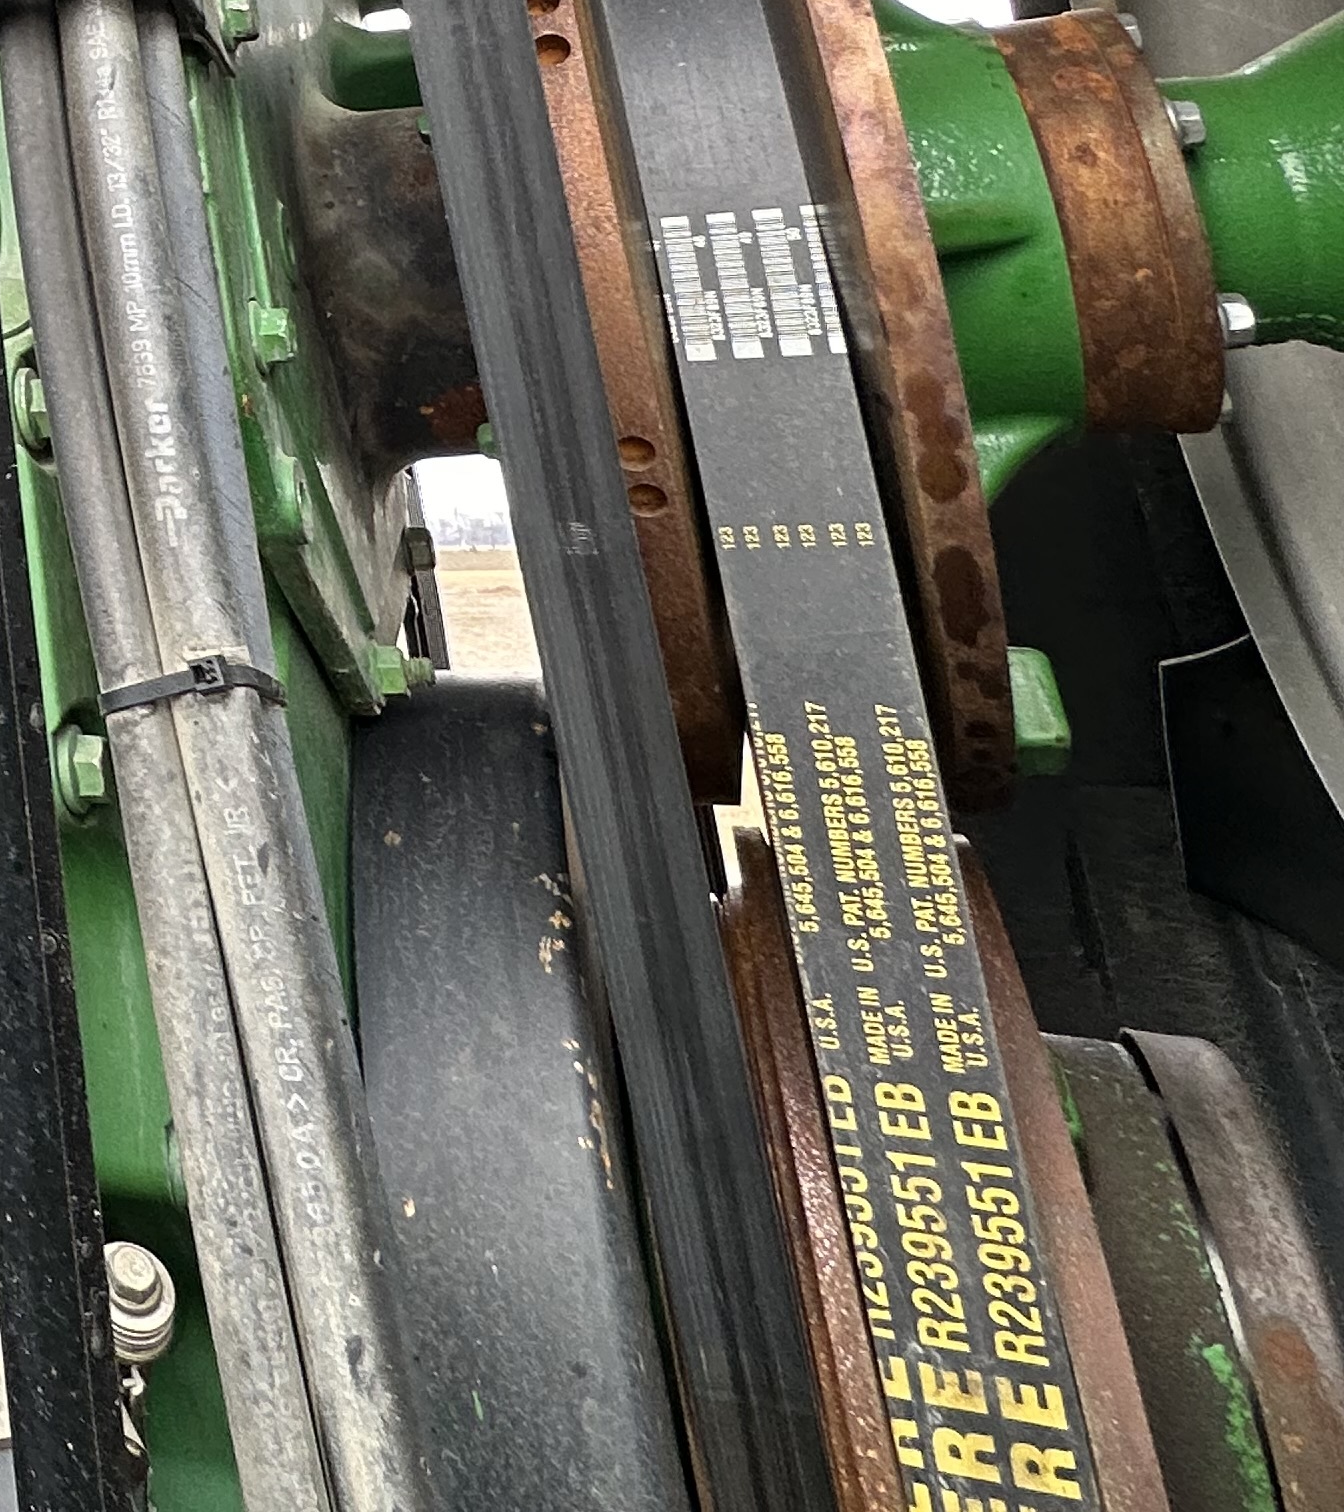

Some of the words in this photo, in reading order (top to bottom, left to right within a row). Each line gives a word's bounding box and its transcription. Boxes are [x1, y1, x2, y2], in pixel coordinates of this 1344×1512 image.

[85, 22, 109, 59] SAE
[120, 233, 143, 292] 10mm
[126, 301, 150, 332] MP
[144, 399, 188, 547] Parker
[718, 526, 737, 550] 123
[743, 525, 761, 550] 123
[772, 524, 791, 548] 123
[797, 524, 816, 548] 123
[828, 523, 848, 547] 123
[854, 522, 875, 547] 123
[804, 700, 840, 789] 5,610,217
[874, 704, 913, 793] 5,610,217
[765, 732, 800, 821] 6,616,558
[833, 735, 871, 824] 6,616,558
[904, 738, 946, 829] 6,616,558
[780, 826, 803, 839] &
[820, 793, 858, 883] NUMBERS
[852, 829, 875, 843] &
[892, 798, 930, 888] NUMBERS
[923, 834, 947, 848] &
[783, 844, 820, 933] 5,645,504
[838, 889, 866, 927] PAT.
[856, 848, 893, 939] 5,645,504
[910, 894, 940, 933] PAT.
[927, 853, 966, 945] 5,645,504
[847, 933, 874, 972] U.S.
[921, 939, 948, 979] U.S.
[812, 993, 840, 1050] U.S.A.
[856, 986, 881, 1007] IN
[928, 992, 955, 1014] IN
[861, 1010, 892, 1066] MADE
[884, 1000, 914, 1058] U.S.A.
[934, 1017, 967, 1074] MADE
[958, 1007, 989, 1067] U.S.A.
[874, 1082, 933, 1140] EB
[948, 1090, 1009, 1150] EB
[885, 1150, 971, 1353] R239551
[961, 1161, 1051, 1367] R239551
